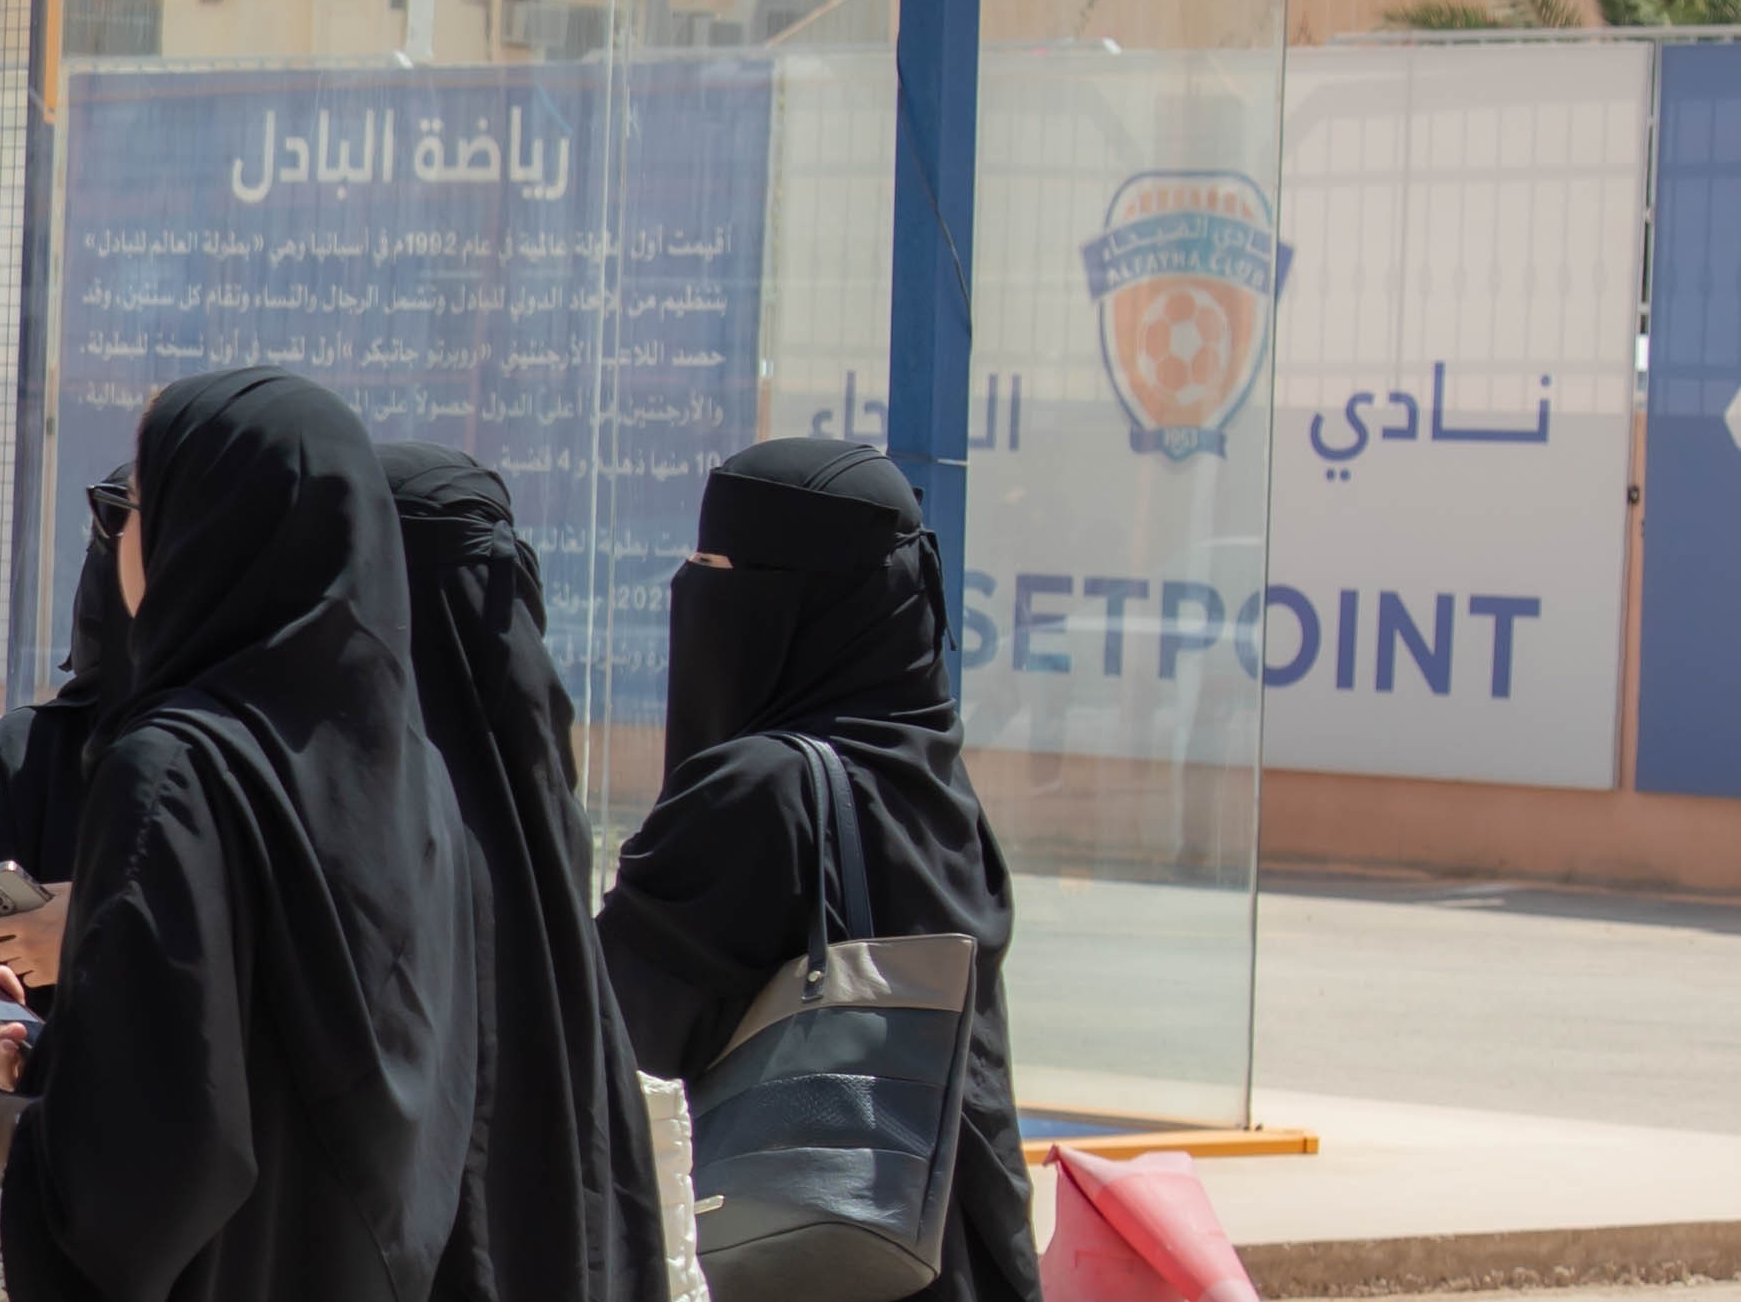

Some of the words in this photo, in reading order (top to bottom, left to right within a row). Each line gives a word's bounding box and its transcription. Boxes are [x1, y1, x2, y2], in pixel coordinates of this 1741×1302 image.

[231, 106, 395, 204] البادل
[412, 105, 572, 202] رياضة
[1308, 360, 1552, 483] نادي
[961, 567, 1542, 699] SETPOINT
